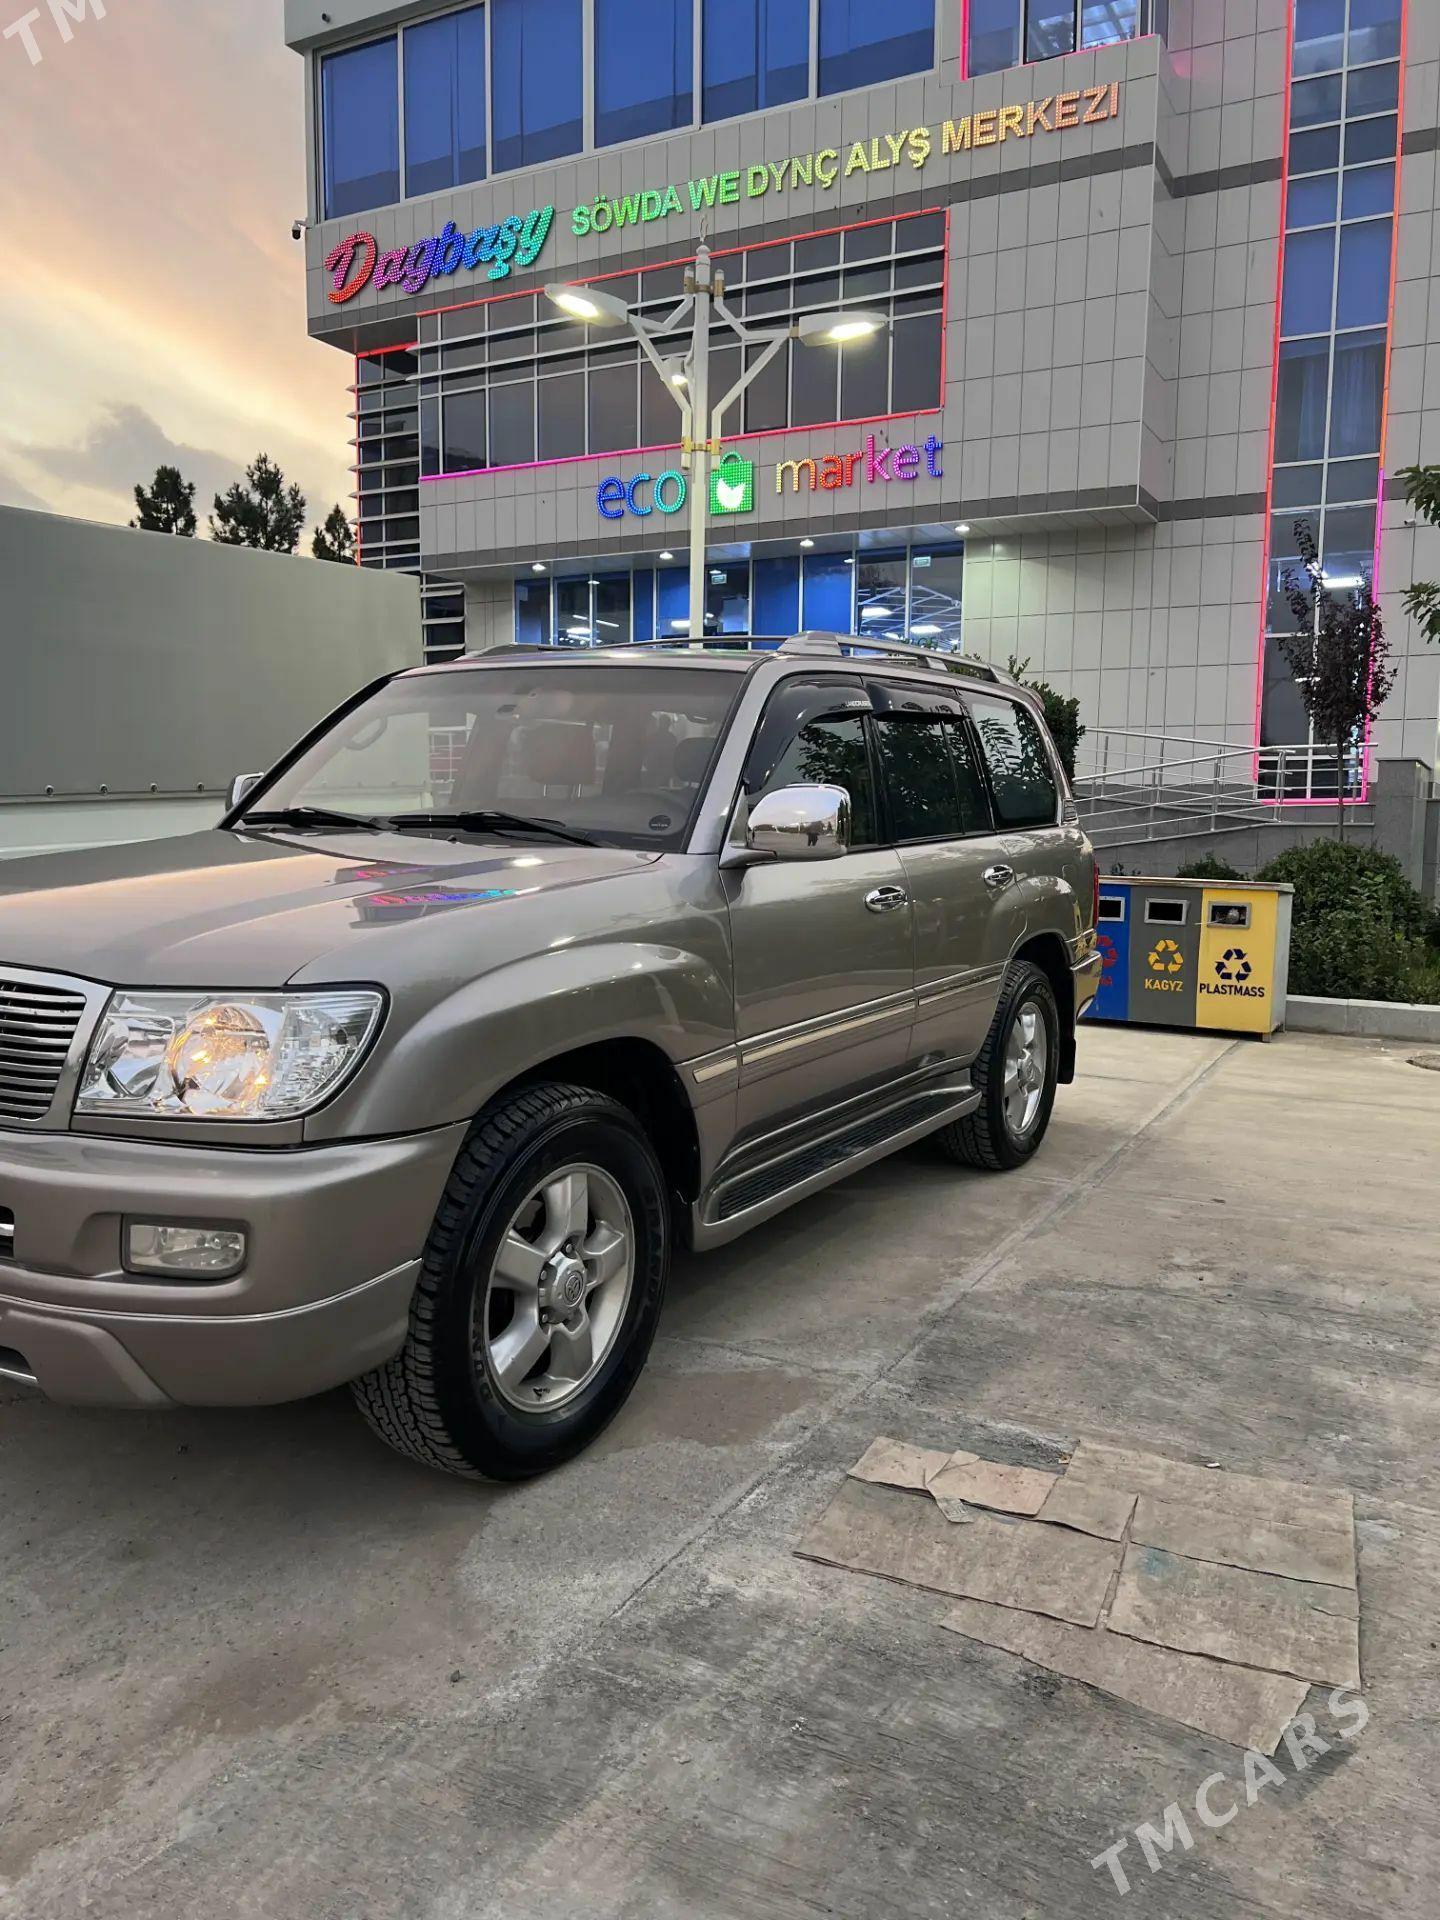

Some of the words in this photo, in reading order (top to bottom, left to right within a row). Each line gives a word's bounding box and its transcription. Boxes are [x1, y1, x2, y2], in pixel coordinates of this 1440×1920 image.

[571, 185, 684, 236] SÖWDA
[688, 170, 740, 212] WE
[747, 148, 838, 198] DYNÇ
[844, 126, 931, 177] ALYŞ
[941, 81, 1119, 155] MERKEZI
[324, 203, 555, 304] Dagbaşy
[596, 468, 687, 519] eco
[776, 432, 943, 494] market
[1144, 978, 1184, 993] KAGYZ
[1199, 982, 1265, 998] PLASTMASS
